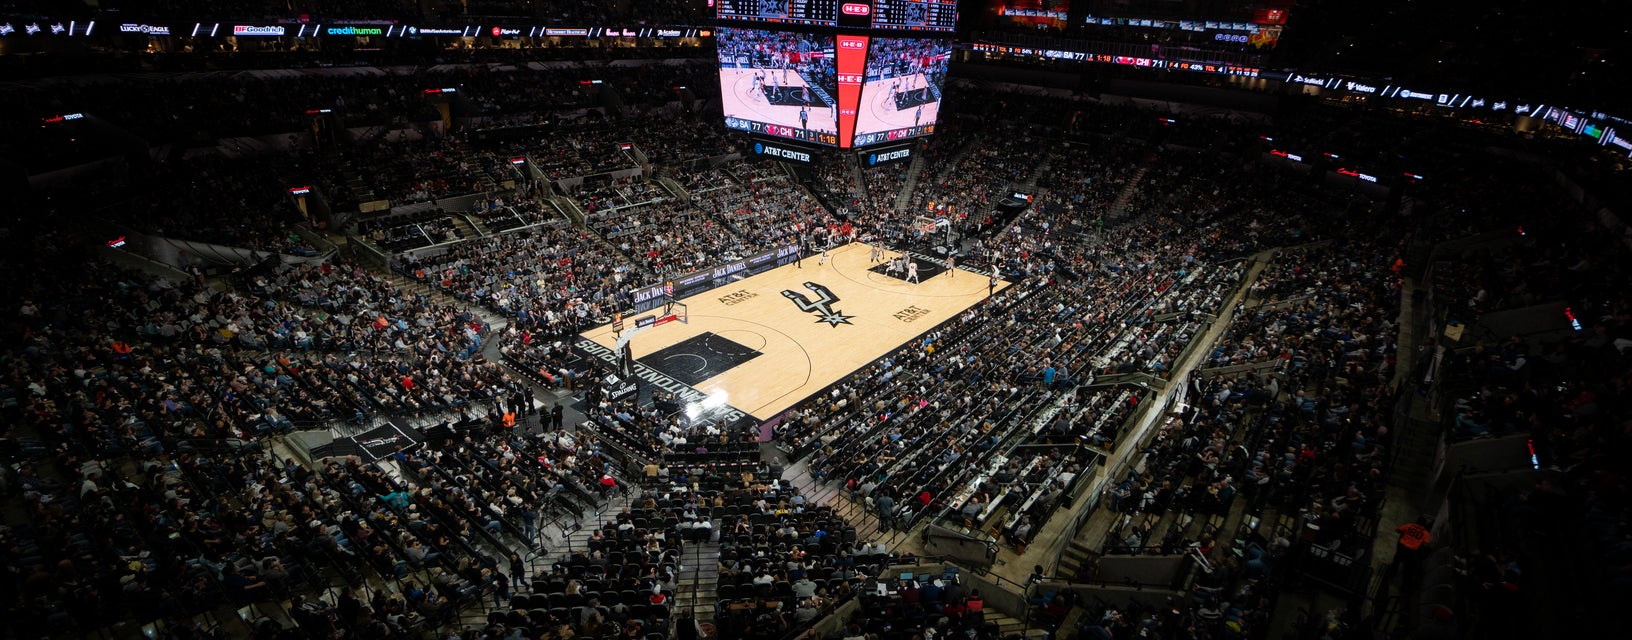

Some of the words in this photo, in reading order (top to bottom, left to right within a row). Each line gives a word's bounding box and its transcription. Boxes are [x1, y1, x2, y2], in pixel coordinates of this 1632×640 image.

[328, 26, 382, 34] credithuman
[1064, 51, 1073, 59] SA
[1355, 84, 1376, 92] Valero
[740, 120, 748, 129] SA
[752, 122, 760, 130] 77
[780, 127, 793, 137] CHI
[795, 130, 804, 138] 71
[819, 134, 836, 144] 1:18
[898, 129, 907, 137] CHI
[908, 128, 914, 136] 71
[764, 146, 780, 156] AT&T
[782, 149, 810, 162] CENTER
[876, 152, 890, 162] AT&T
[890, 149, 909, 160] CENTER
[1359, 174, 1377, 182] TOYOTA
[777, 248, 788, 258] JACK
[713, 268, 726, 278] JACK
[726, 262, 747, 274] DANIEL'S
[635, 290, 651, 303] JACK
[718, 289, 750, 303] AT&T
[725, 293, 760, 306] CENTER
[892, 305, 921, 320] AT&T
[903, 309, 931, 322] CENTER
[612, 382, 637, 400] SPALDING
